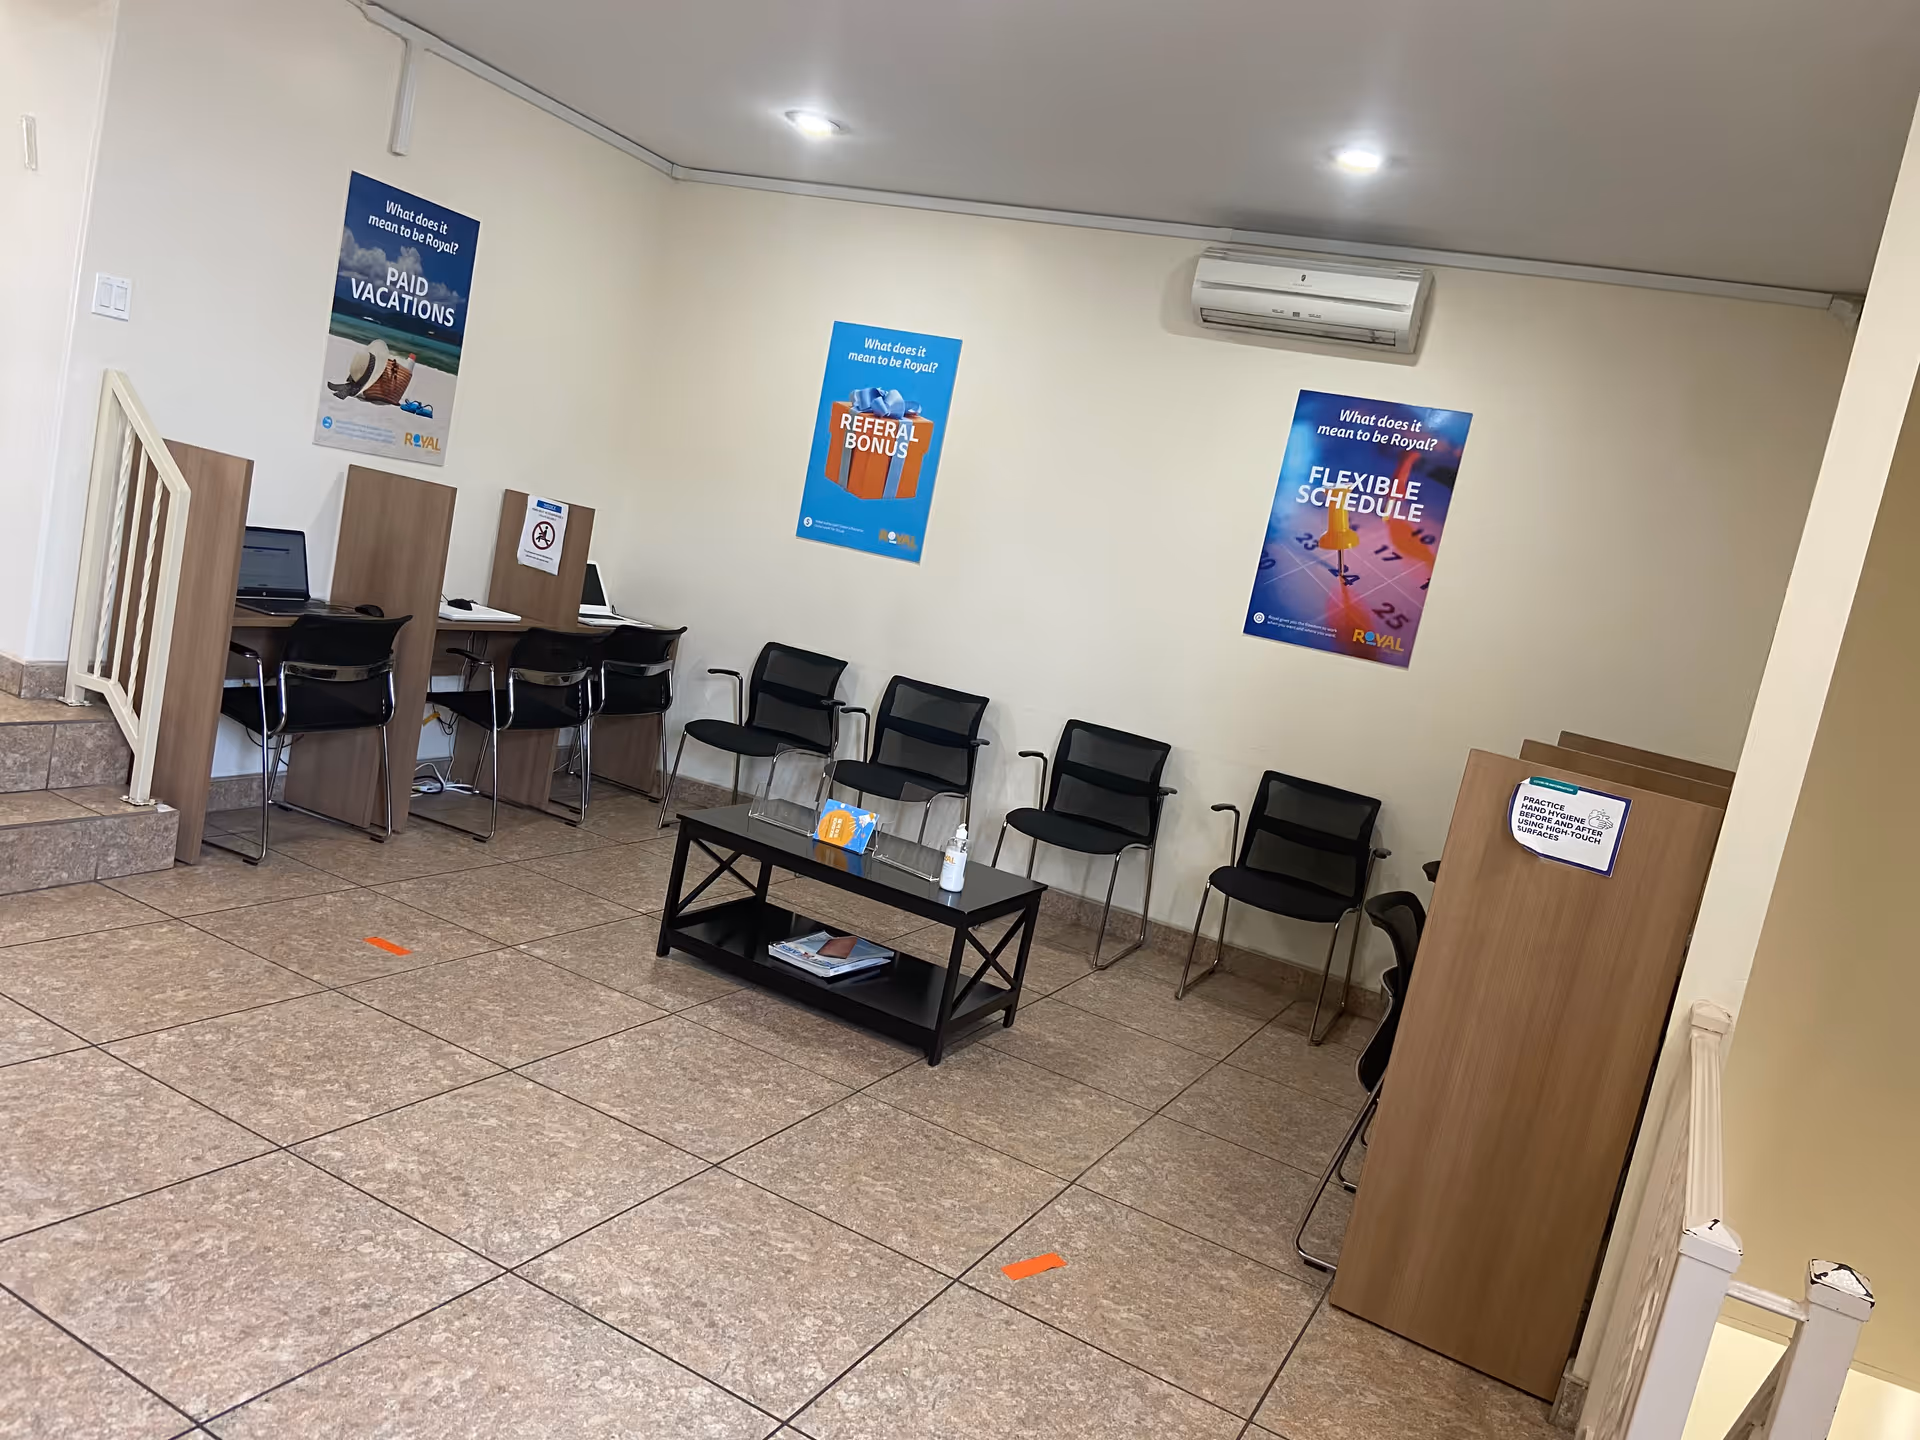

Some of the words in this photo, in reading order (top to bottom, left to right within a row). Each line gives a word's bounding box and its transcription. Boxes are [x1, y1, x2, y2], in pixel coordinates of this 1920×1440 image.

[386, 200, 414, 222] What
[416, 213, 438, 232] does
[440, 222, 448, 235] it
[368, 215, 398, 234] mean
[400, 225, 410, 238] to
[412, 228, 424, 242] be
[426, 234, 459, 255] Royal?
[387, 267, 428, 296] PAID
[351, 278, 455, 326] VACATIONS
[864, 338, 892, 351] What
[893, 343, 917, 356] does
[918, 346, 926, 357] it
[848, 353, 876, 364] mean
[878, 356, 888, 366] to
[889, 356, 901, 368] be
[903, 359, 938, 373] Royal?
[840, 414, 919, 442] REFERAL
[1339, 409, 1376, 426] What
[1378, 416, 1408, 430] does
[1411, 420, 1421, 432] it
[404, 432, 441, 451] ROYAL
[845, 433, 908, 458] BONUS
[1318, 426, 1353, 439] mean
[1356, 430, 1370, 441] to
[1372, 431, 1389, 444] be
[1391, 434, 1438, 451] Royal?
[1309, 466, 1421, 500] FLEXIBLE
[1296, 484, 1424, 522] SCHEDULE
[1374, 545, 1403, 562] 17
[1328, 565, 1360, 586] 24
[1372, 602, 1410, 630] 25
[1353, 629, 1404, 652] ROYAL
[1521, 803, 1546, 814] HAND
[1548, 810, 1586, 824] HYGIENE
[1523, 796, 1565, 811] PRACTICE
[1517, 825, 1559, 841] SURFACES
[1518, 818, 1543, 829] USING
[1546, 825, 1601, 845] HIGH-TOUCH
[1520, 811, 1552, 824] BEFORE
[1554, 820, 1573, 829] AND
[1575, 826, 1603, 837] AFTER
